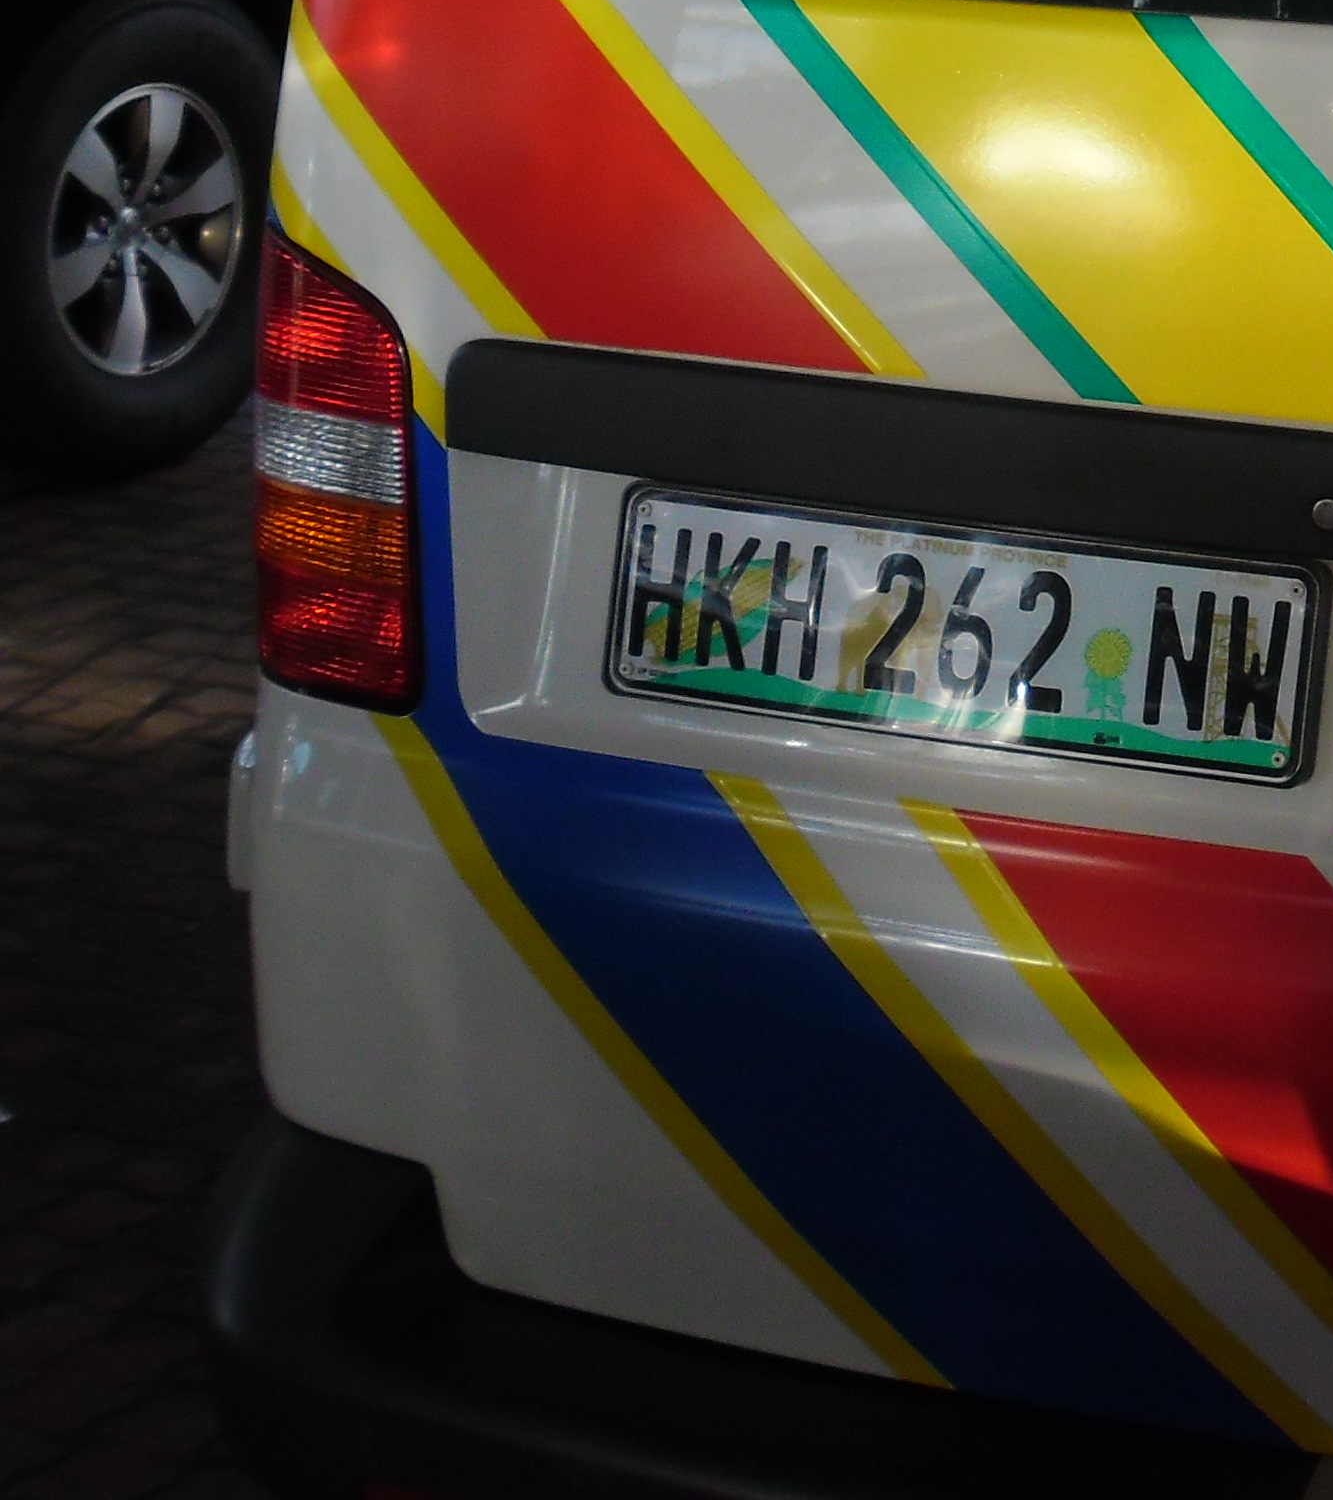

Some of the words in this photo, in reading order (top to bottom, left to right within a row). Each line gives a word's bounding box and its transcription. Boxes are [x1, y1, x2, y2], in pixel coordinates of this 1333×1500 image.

[855, 529, 886, 546] THE
[890, 534, 975, 557] PLATINUM
[980, 546, 1069, 568] PROVINCE
[627, 523, 828, 681] HKH
[864, 553, 1072, 714] 262
[1142, 586, 1292, 741] NW
